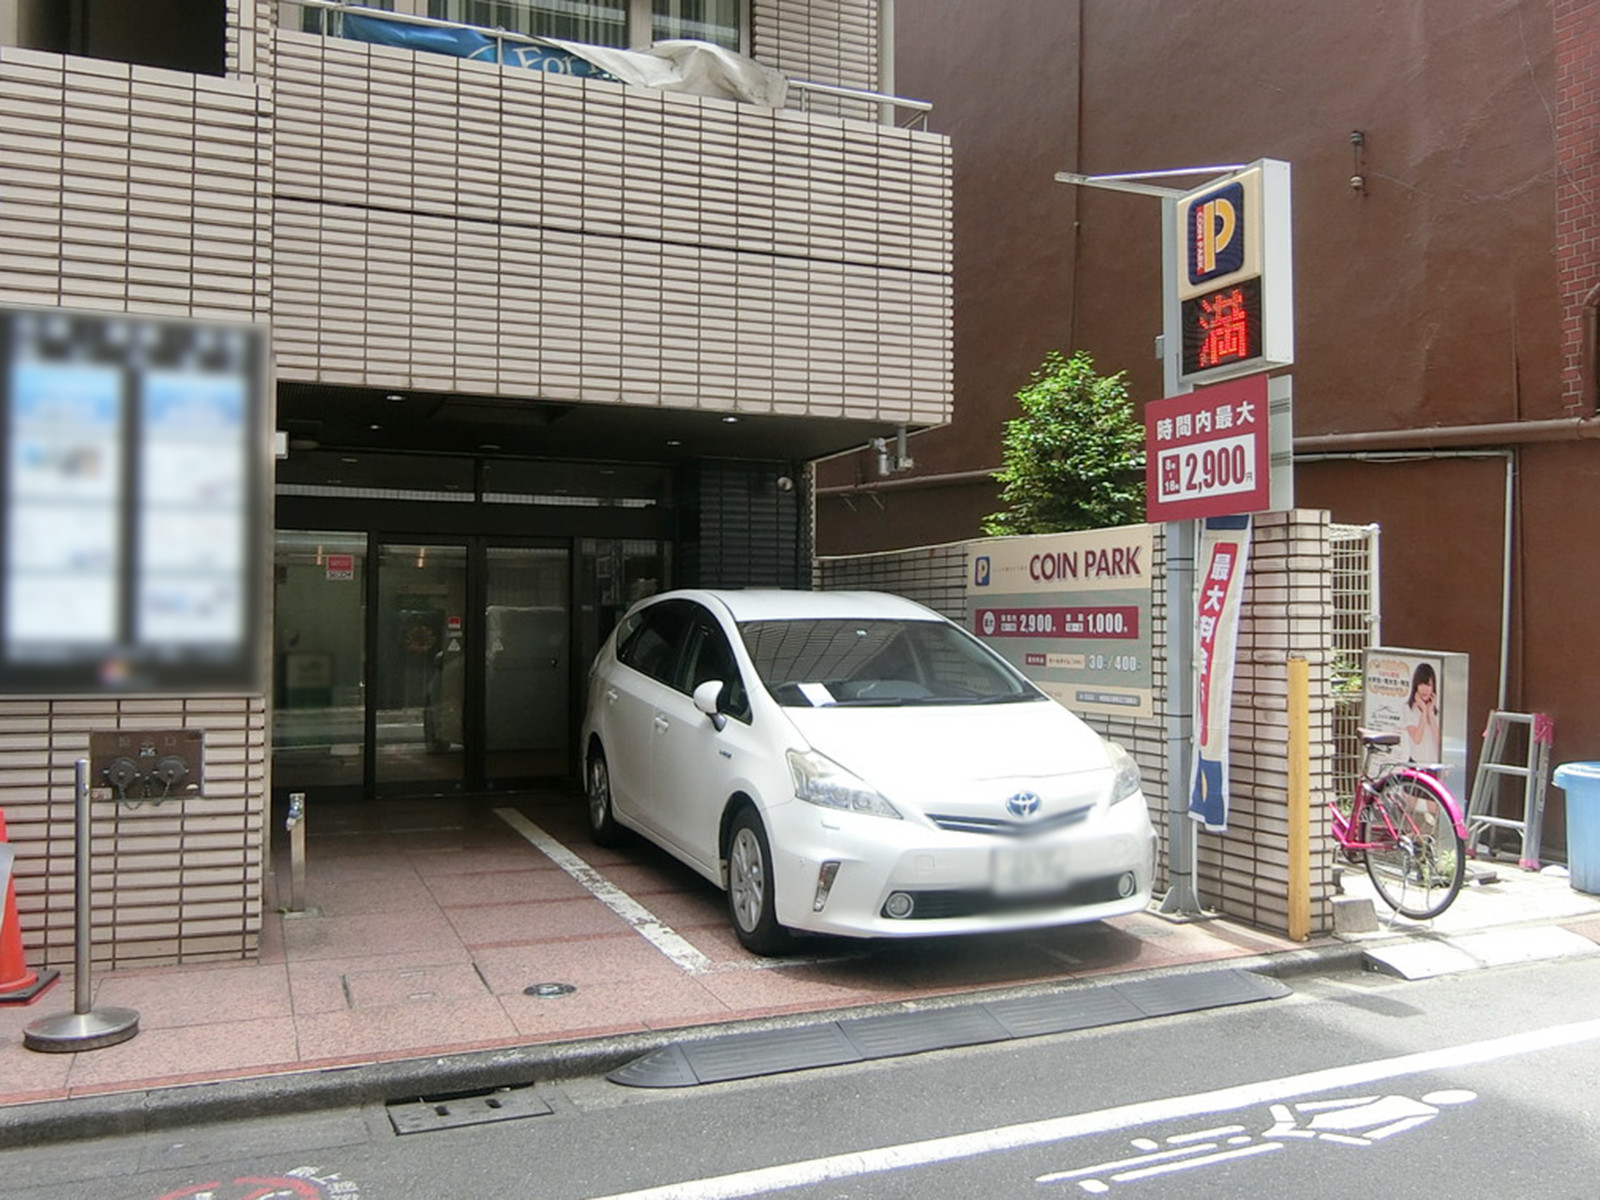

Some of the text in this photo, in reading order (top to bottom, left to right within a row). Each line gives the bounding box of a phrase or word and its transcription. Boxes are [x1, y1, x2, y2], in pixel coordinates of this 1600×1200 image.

[1199, 288, 1249, 367] 満
[1156, 401, 1256, 441] 時間内最大
[1029, 546, 1141, 582] COIN PARK
